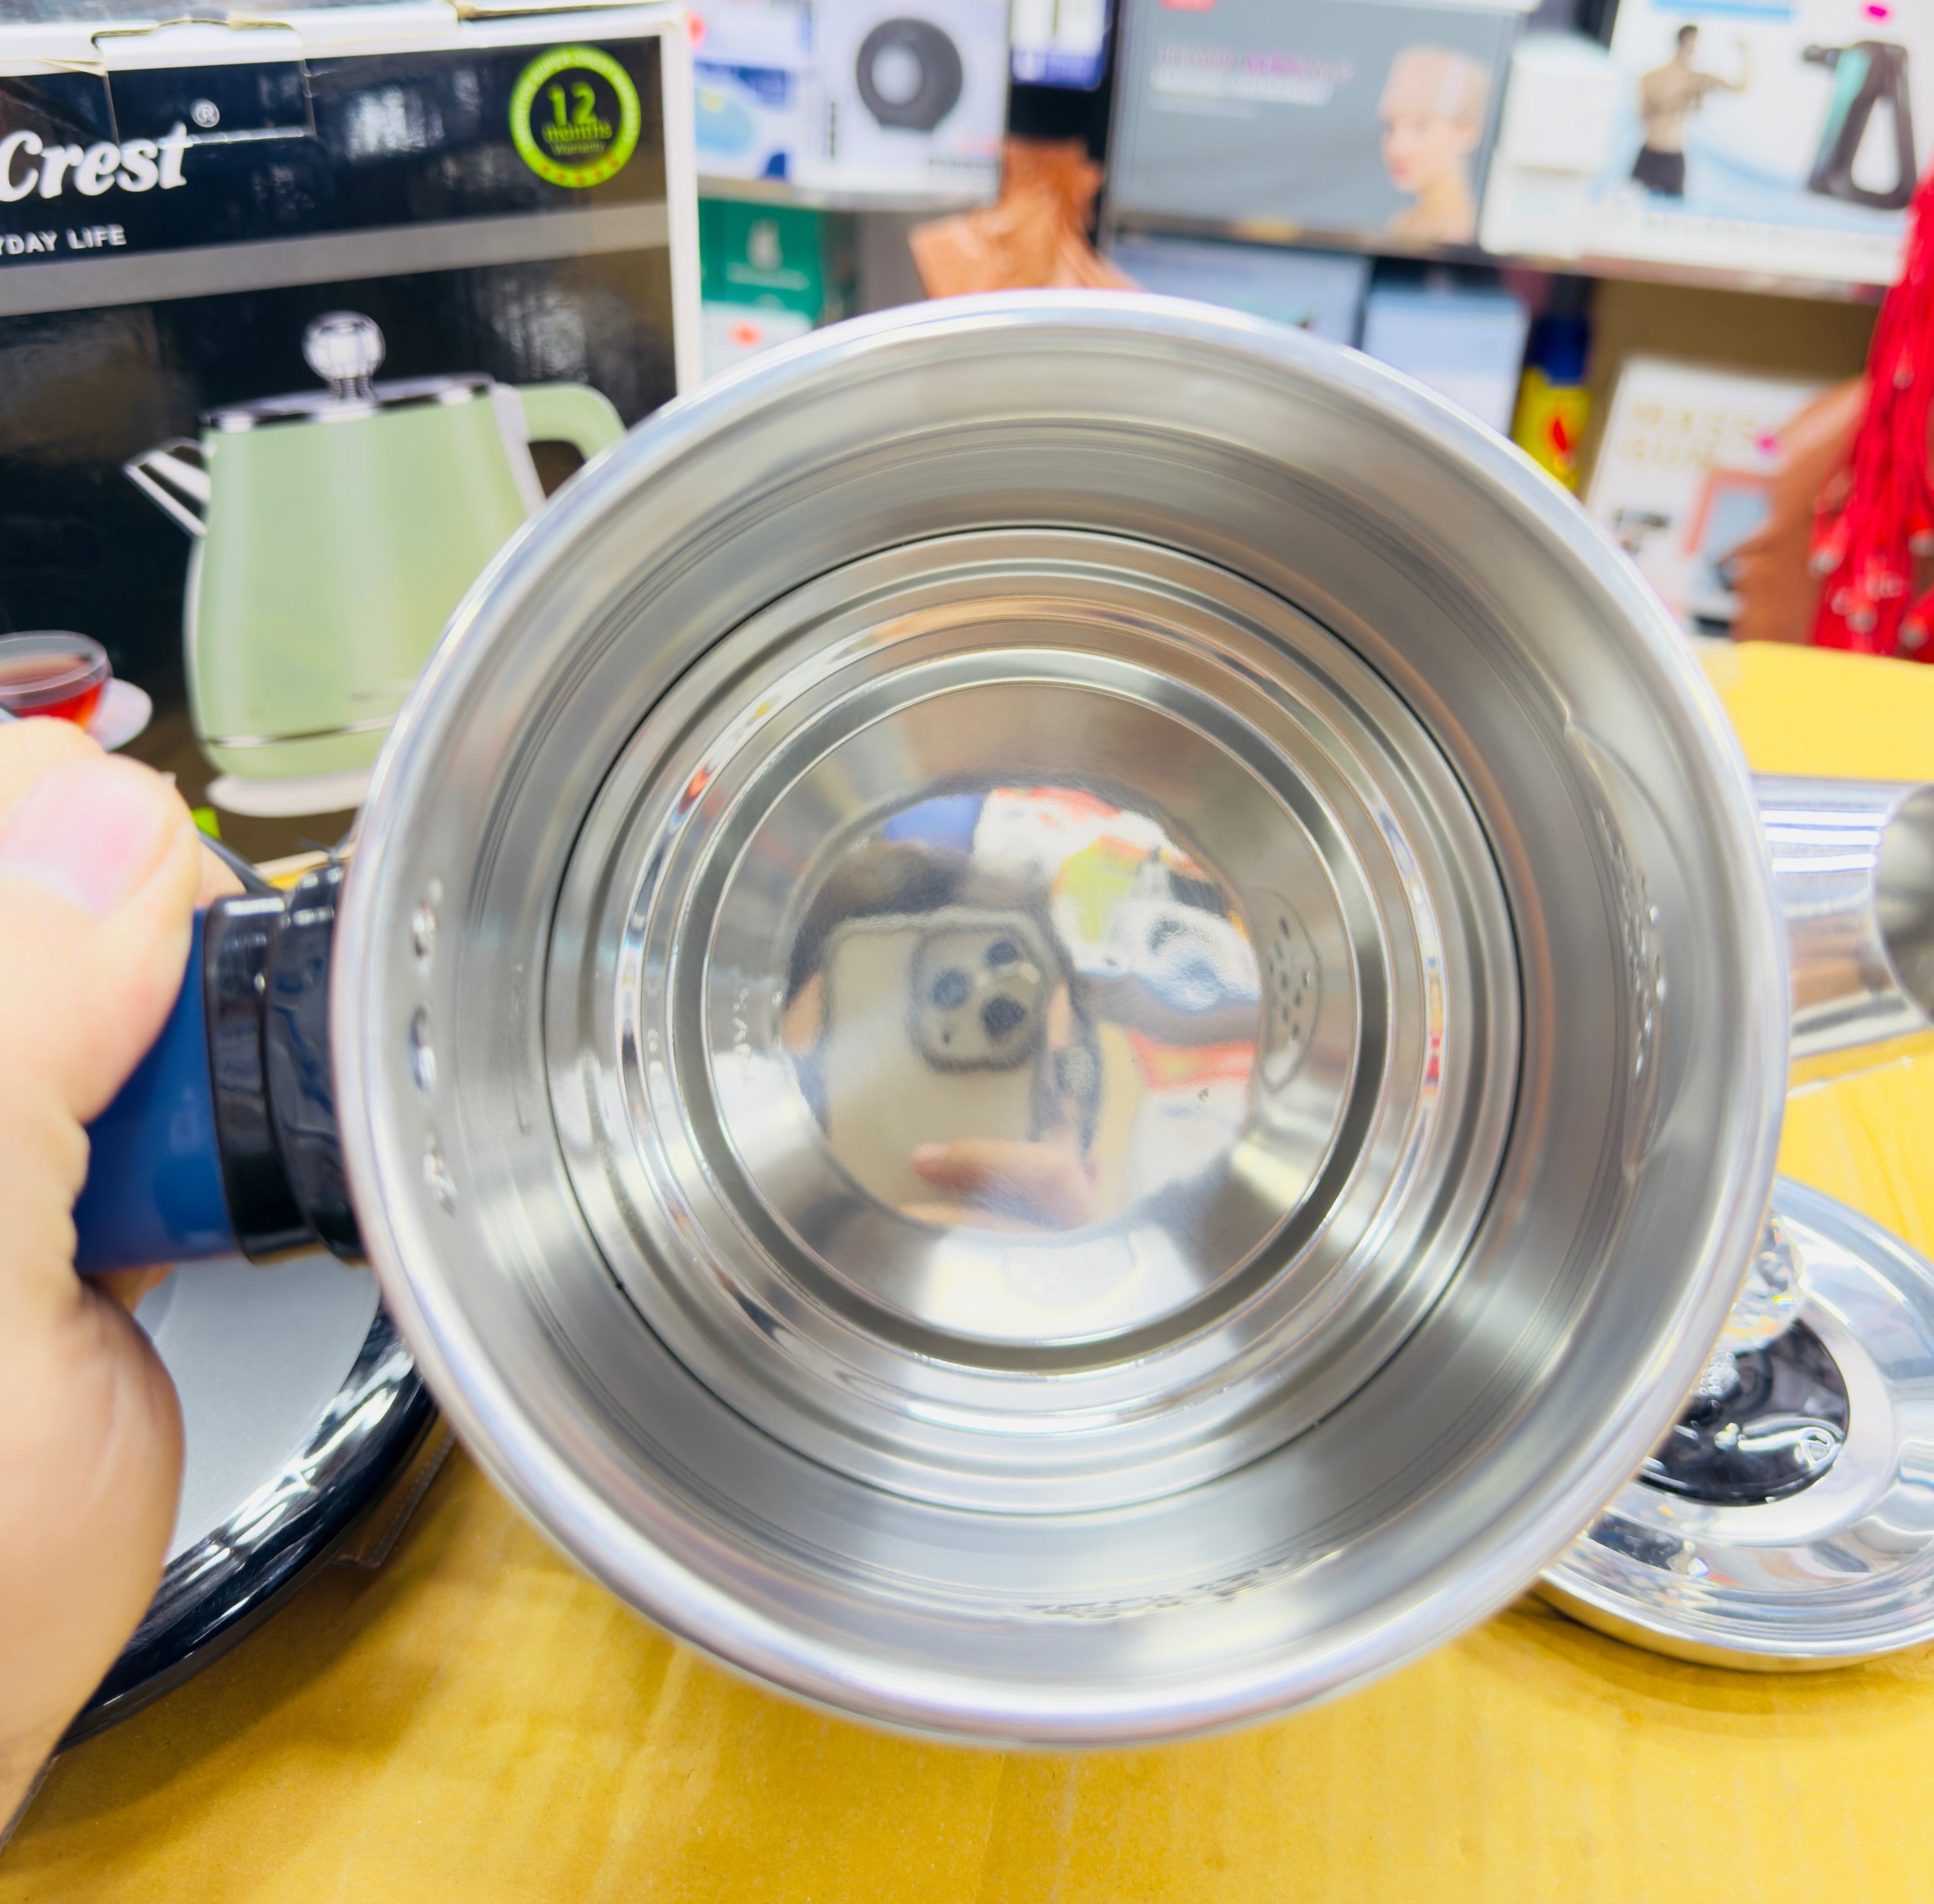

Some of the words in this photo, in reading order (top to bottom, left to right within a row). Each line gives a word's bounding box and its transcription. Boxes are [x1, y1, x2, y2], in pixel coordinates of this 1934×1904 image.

[547, 81, 596, 126] 12
[541, 119, 612, 143] months
[66, 224, 126, 249] LIFE
